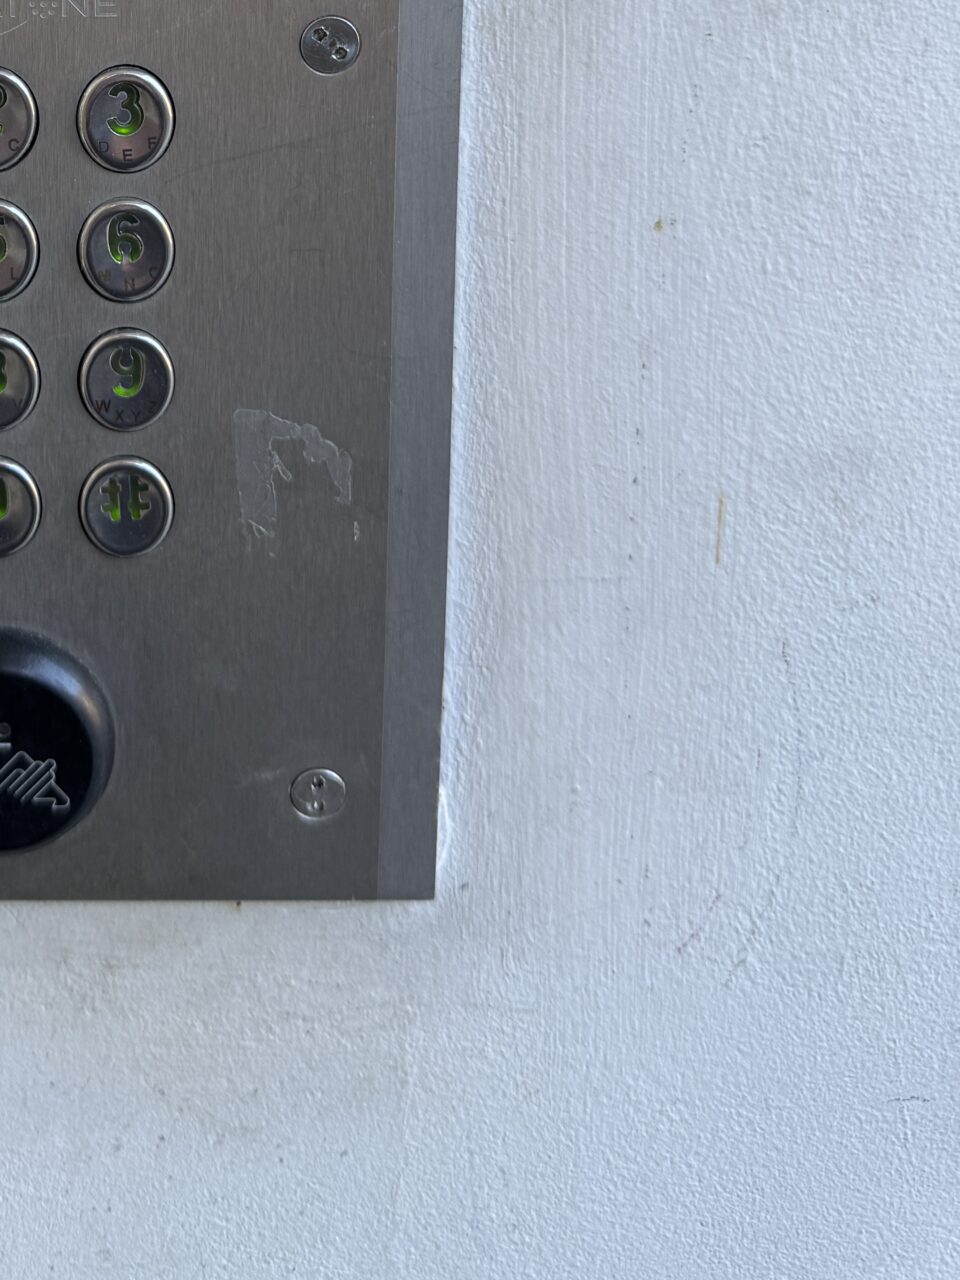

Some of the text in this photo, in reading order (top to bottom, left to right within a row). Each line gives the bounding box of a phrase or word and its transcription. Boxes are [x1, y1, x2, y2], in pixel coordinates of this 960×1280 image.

[106, 82, 145, 136] 3
[106, 214, 144, 265] 6
[109, 346, 146, 398] 9
